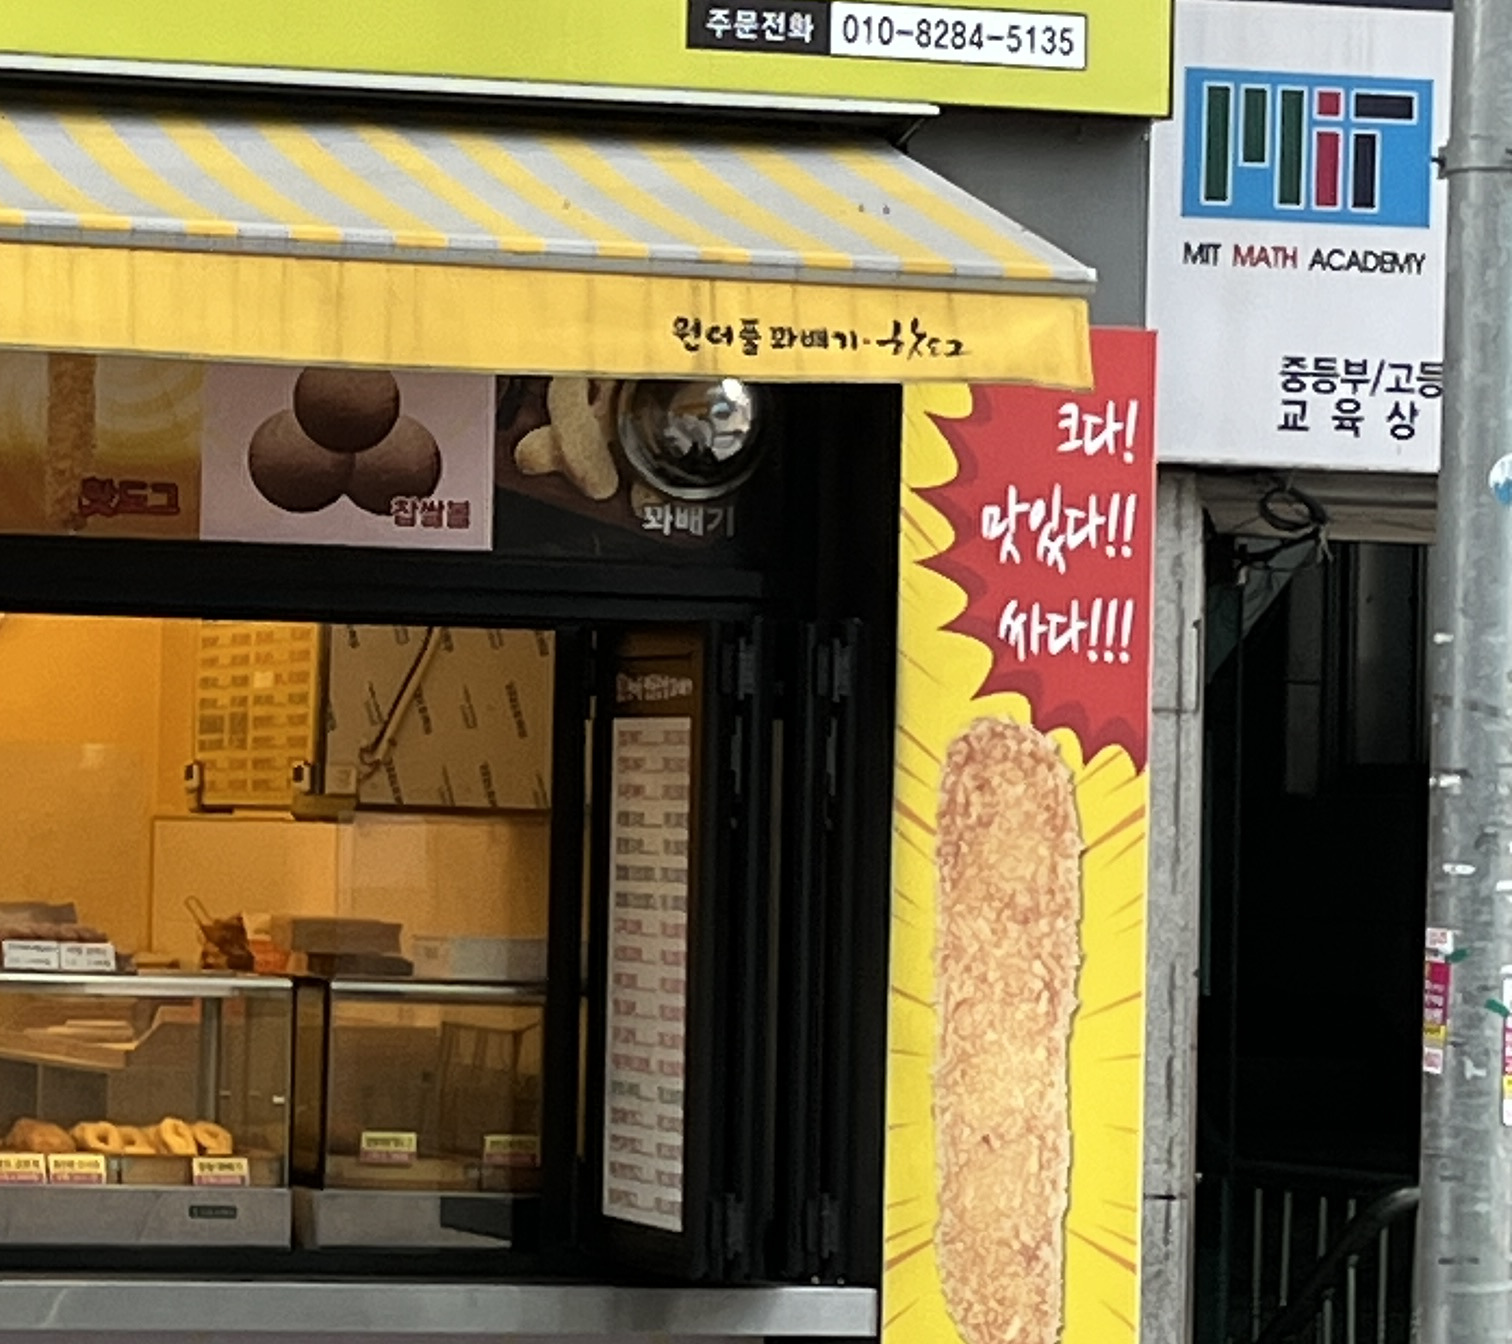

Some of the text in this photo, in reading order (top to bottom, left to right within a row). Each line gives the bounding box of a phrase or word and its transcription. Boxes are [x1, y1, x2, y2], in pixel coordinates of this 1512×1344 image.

[705, 8, 1075, 56] 주문전화 010-8284-5135
[1183, 241, 1426, 275] MIT MATH ACADEMY
[1056, 399, 1138, 464] 크다!
[641, 502, 735, 537] 꽈배기
[981, 482, 1138, 575] 맛있다!!
[997, 597, 1135, 663] 싸다!!!
